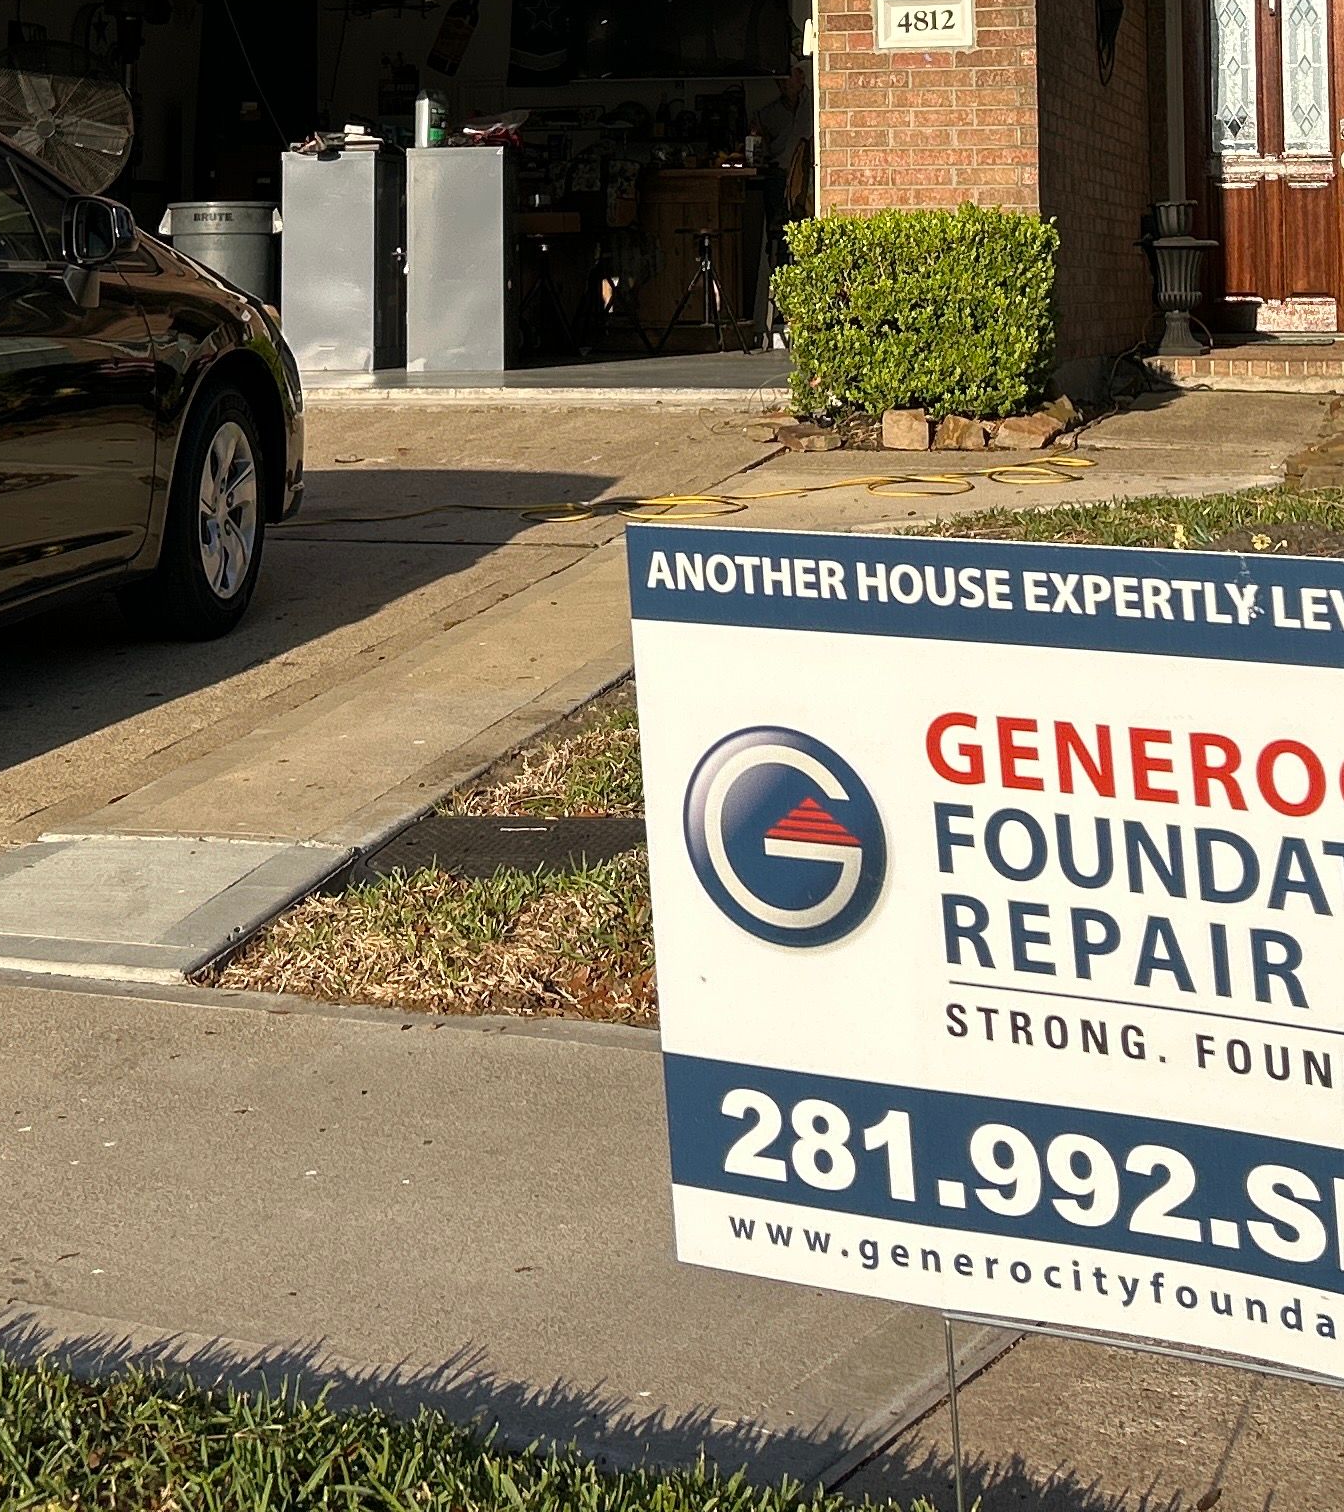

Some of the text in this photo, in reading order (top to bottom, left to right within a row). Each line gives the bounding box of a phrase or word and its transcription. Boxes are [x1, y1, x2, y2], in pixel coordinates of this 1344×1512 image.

[897, 9, 955, 33] 4812
[193, 212, 234, 222] BRUTE
[648, 552, 847, 599] ANOTHER
[856, 562, 1012, 609] HOUSE
[1023, 572, 1258, 624] EXPERTLY
[942, 894, 1309, 1008] REPAIR
[946, 1004, 1167, 1064] STRONG.
